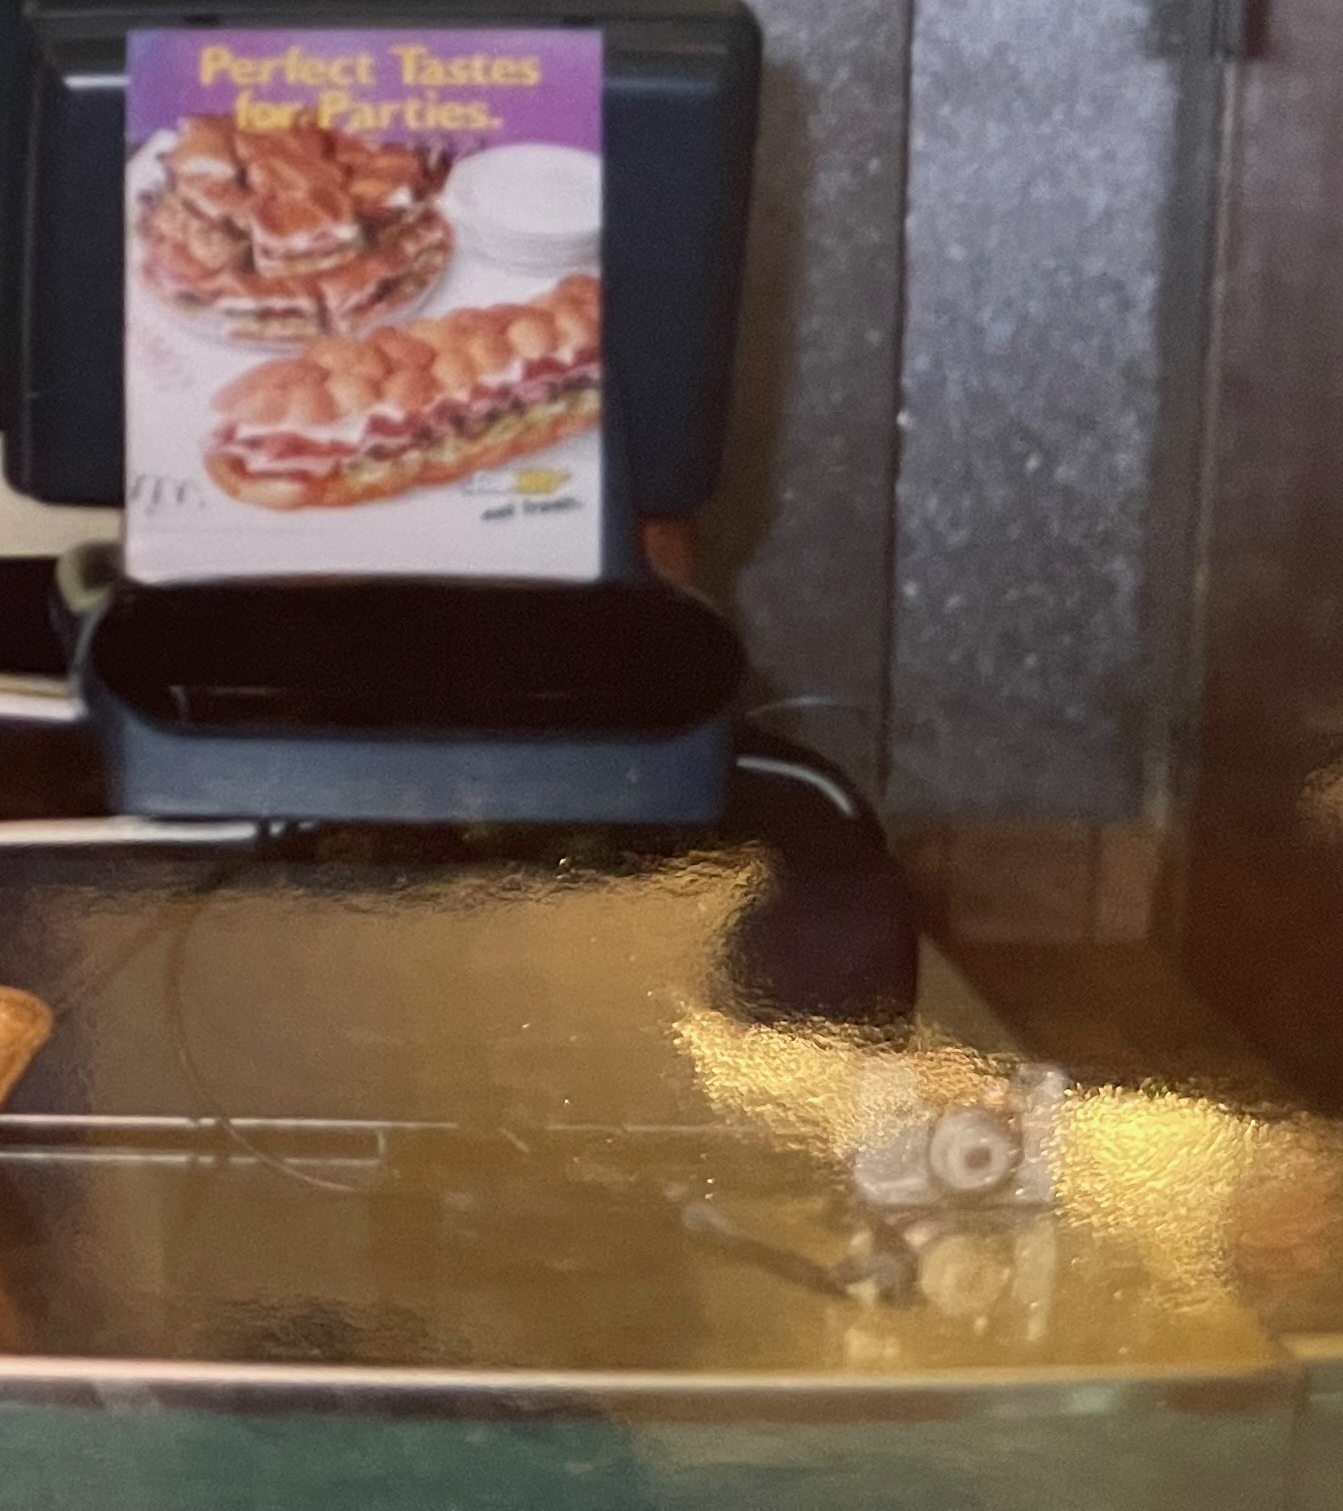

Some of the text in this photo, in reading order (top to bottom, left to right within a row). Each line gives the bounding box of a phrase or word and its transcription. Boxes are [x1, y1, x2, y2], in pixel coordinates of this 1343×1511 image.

[199, 44, 542, 87] Perfect Tastes
[235, 89, 303, 131] for
